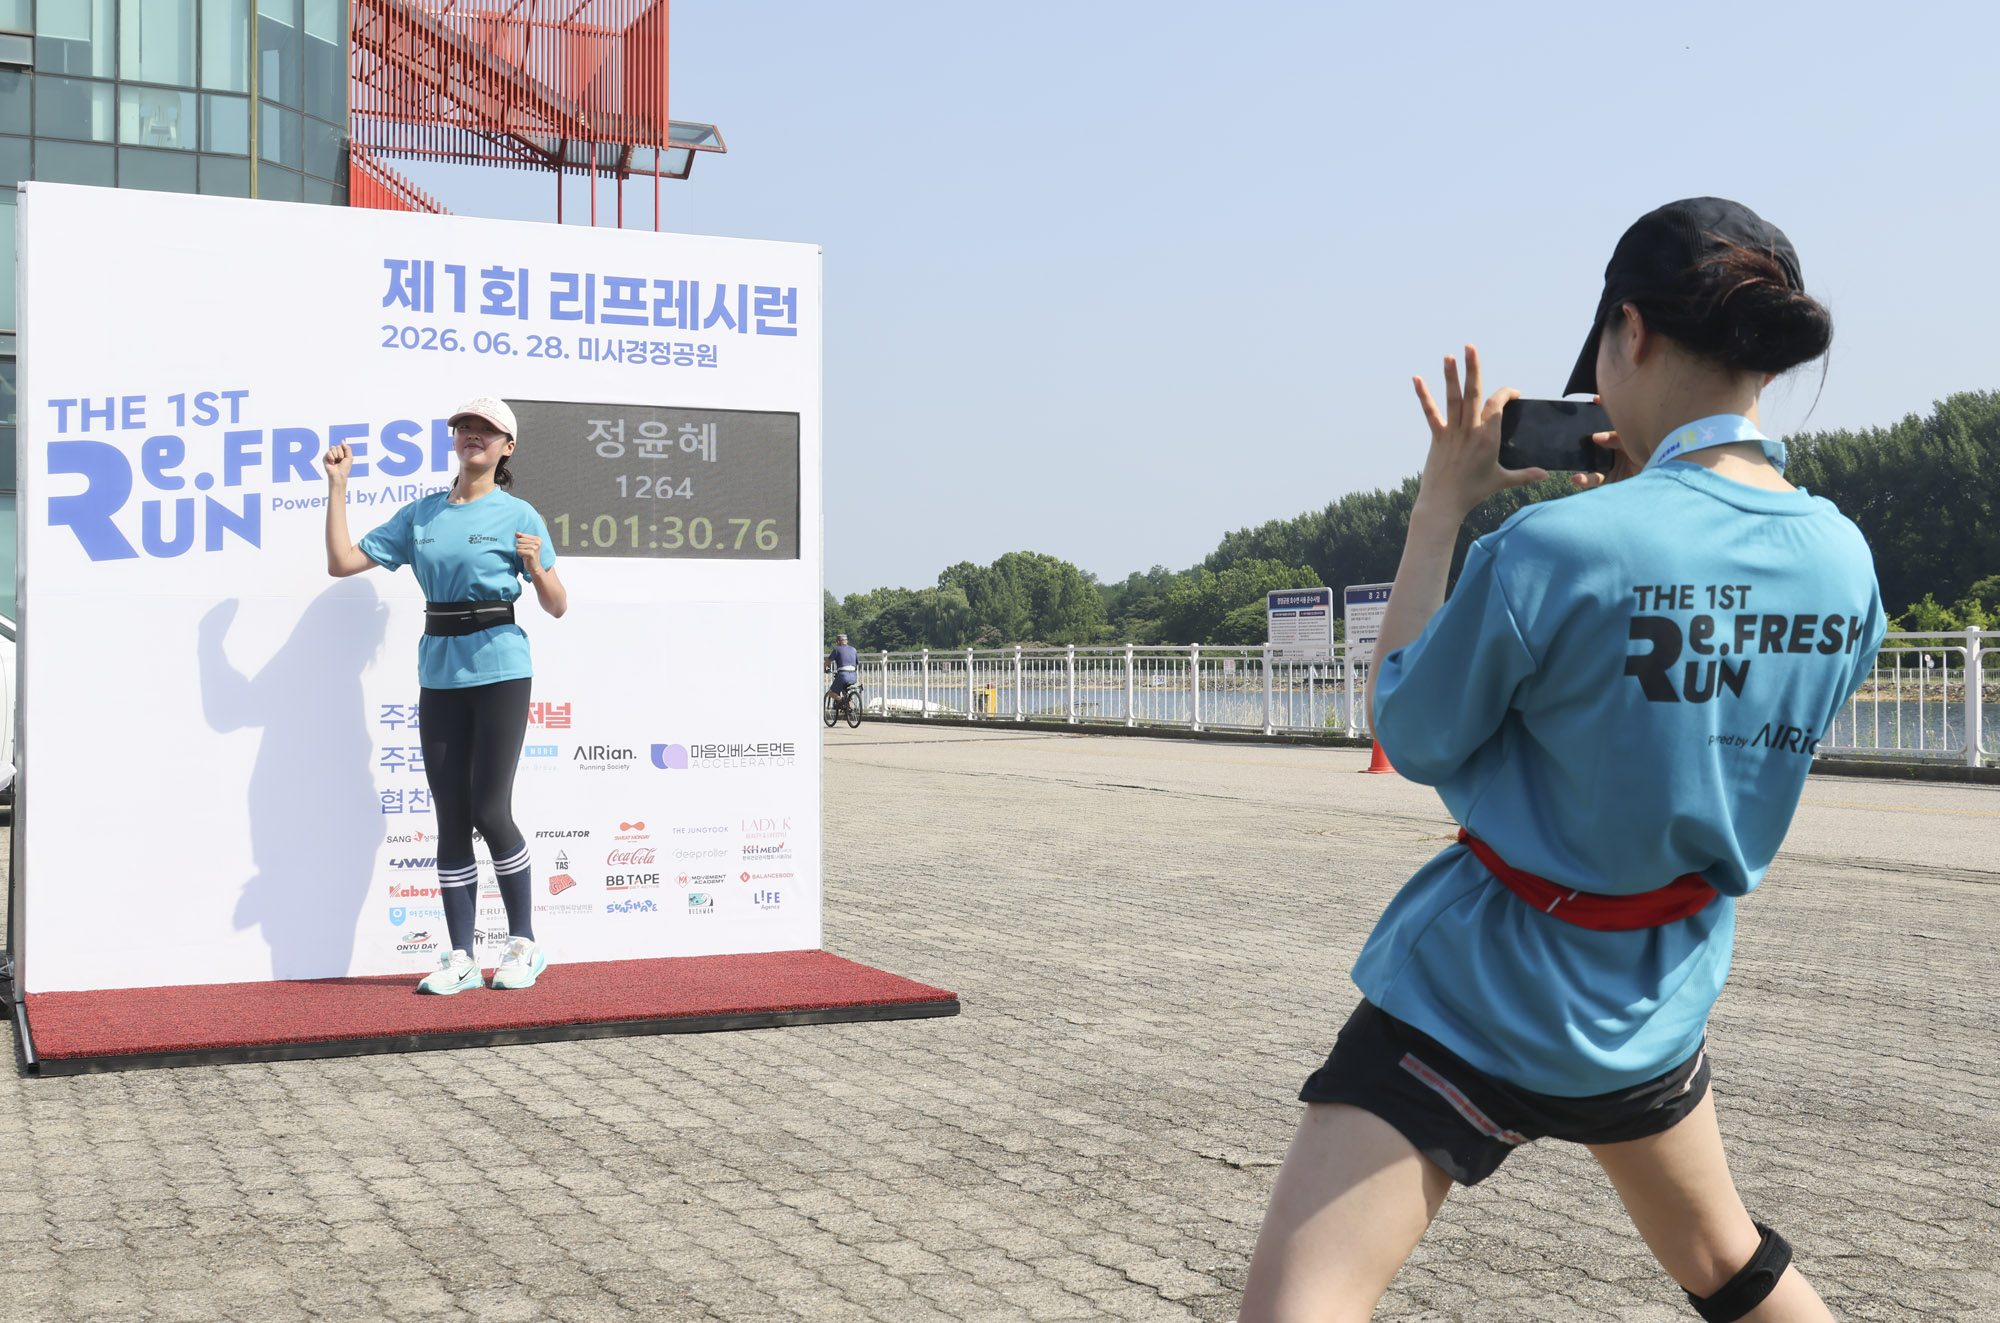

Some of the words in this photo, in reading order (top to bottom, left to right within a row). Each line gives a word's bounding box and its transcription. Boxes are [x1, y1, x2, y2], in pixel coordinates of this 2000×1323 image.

[382, 258, 529, 320] 제1회
[550, 271, 798, 337] 리프레시런
[381, 324, 466, 353] 2026.
[473, 330, 518, 356] 06.
[526, 334, 570, 359] 28.
[578, 337, 718, 368] 미사경정공원
[48, 395, 146, 433] THE
[167, 390, 249, 427] 1ST
[586, 418, 717, 462] 정윤혜
[615, 474, 694, 500] 1264
[272, 490, 351, 511] Powerd
[357, 489, 377, 505] by
[542, 512, 779, 551] 1:01:30.76
[1633, 585, 1694, 611] THE
[1706, 585, 1751, 610] 1ST
[690, 742, 795, 758] 마음인베스트먼트
[579, 764, 606, 772] Running
[606, 763, 630, 771] Society
[692, 757, 795, 769] ACCELERATOR
[380, 788, 433, 814] 협찬
[687, 826, 728, 834] JUNGYOOK
[741, 818, 776, 831] LADY
[783, 817, 791, 830] K
[386, 835, 412, 844] SANG
[535, 830, 590, 838] FITCULATOR
[675, 848, 728, 861] deeproller
[555, 861, 569, 870] TAS
[606, 875, 625, 886] BB
[626, 873, 660, 885] TAPE
[606, 899, 658, 913] SUNSHADE
